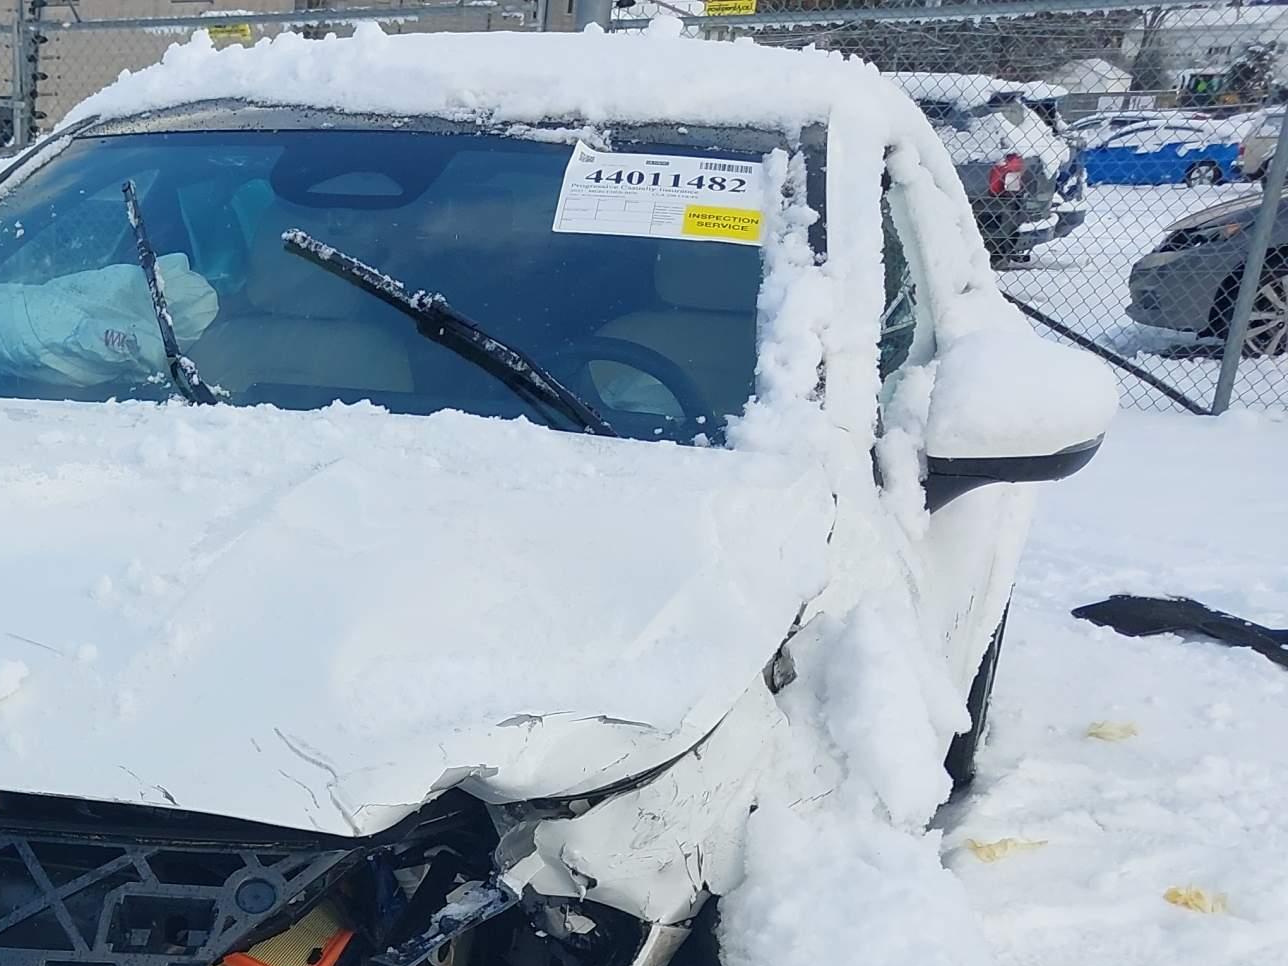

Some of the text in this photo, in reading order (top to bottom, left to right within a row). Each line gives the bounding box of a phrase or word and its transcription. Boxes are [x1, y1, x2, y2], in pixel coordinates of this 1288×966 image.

[585, 168, 747, 194] 44011482
[688, 212, 760, 225] INSPECTION
[696, 221, 750, 232] SERVICE
